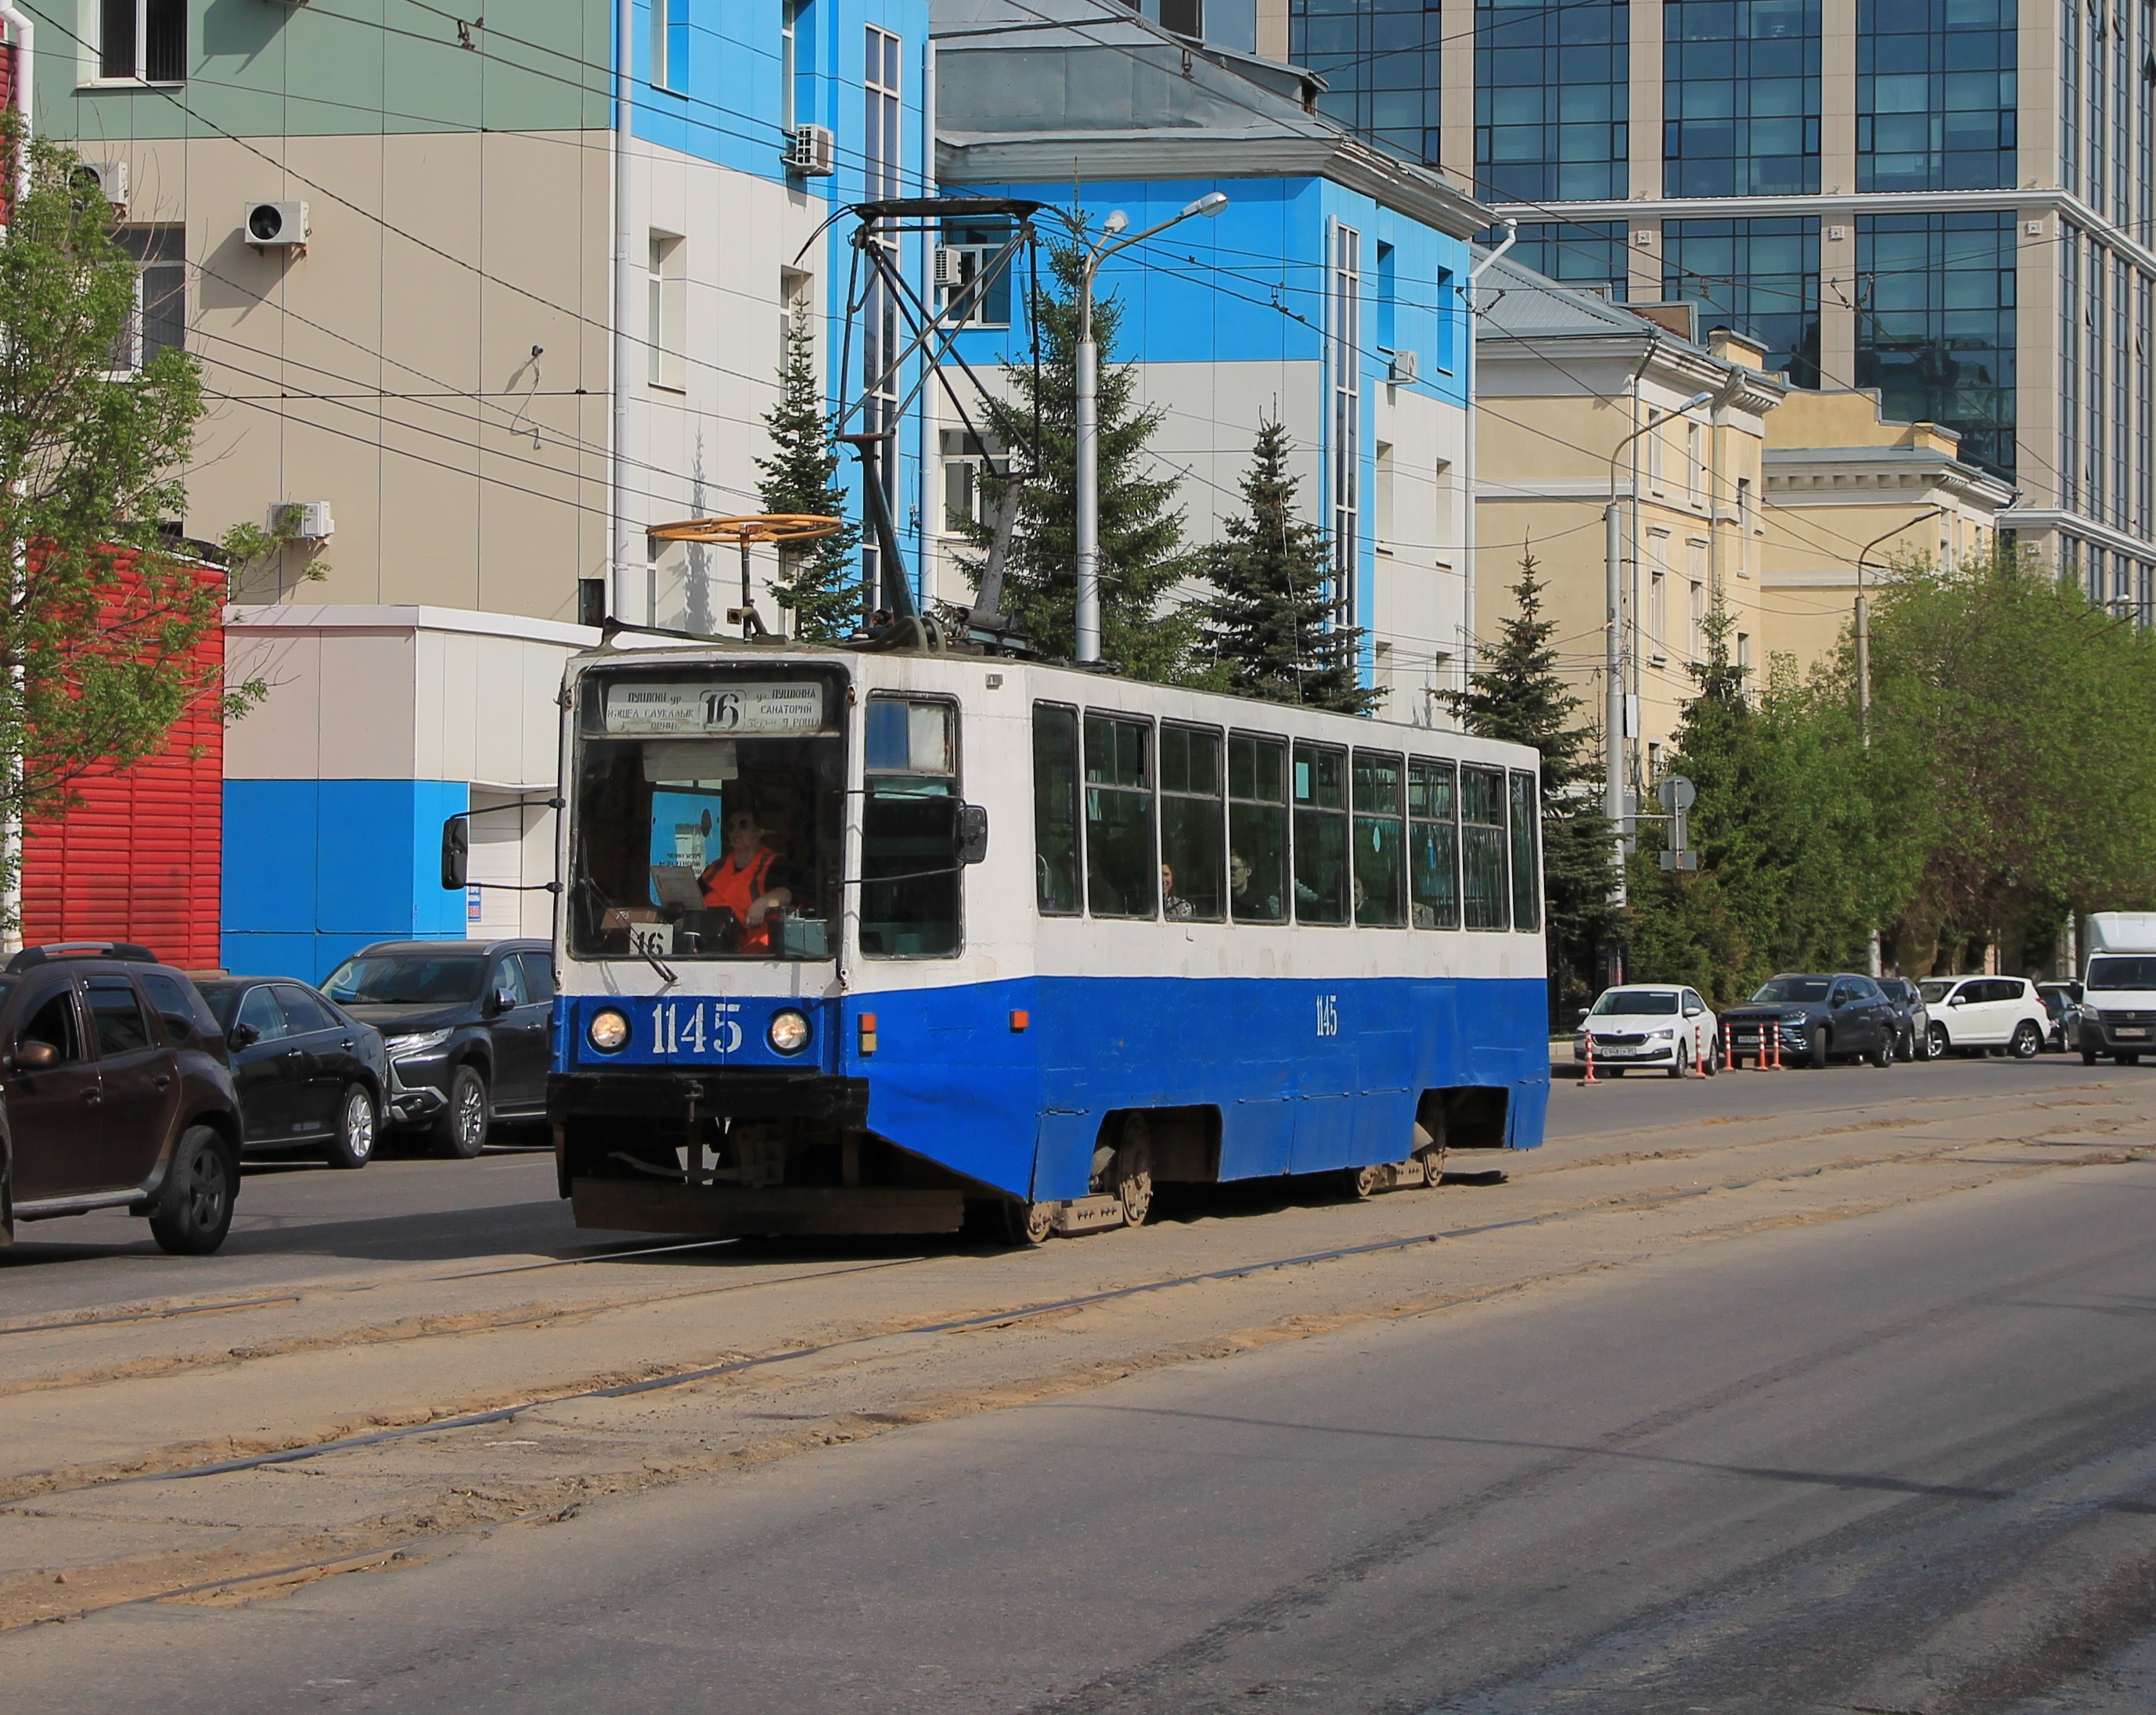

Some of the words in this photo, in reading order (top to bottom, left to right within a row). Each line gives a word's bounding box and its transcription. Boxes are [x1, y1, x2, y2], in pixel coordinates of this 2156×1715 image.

[628, 692, 667, 703] ПУШКИН
[772, 689, 816, 699] ПУШКИНА
[706, 693, 740, 731] 16
[761, 703, 812, 714] САНАТОРИЙ
[638, 931, 664, 955] 16
[1316, 994, 1337, 1036] 1145
[652, 1002, 743, 1053] 1145
